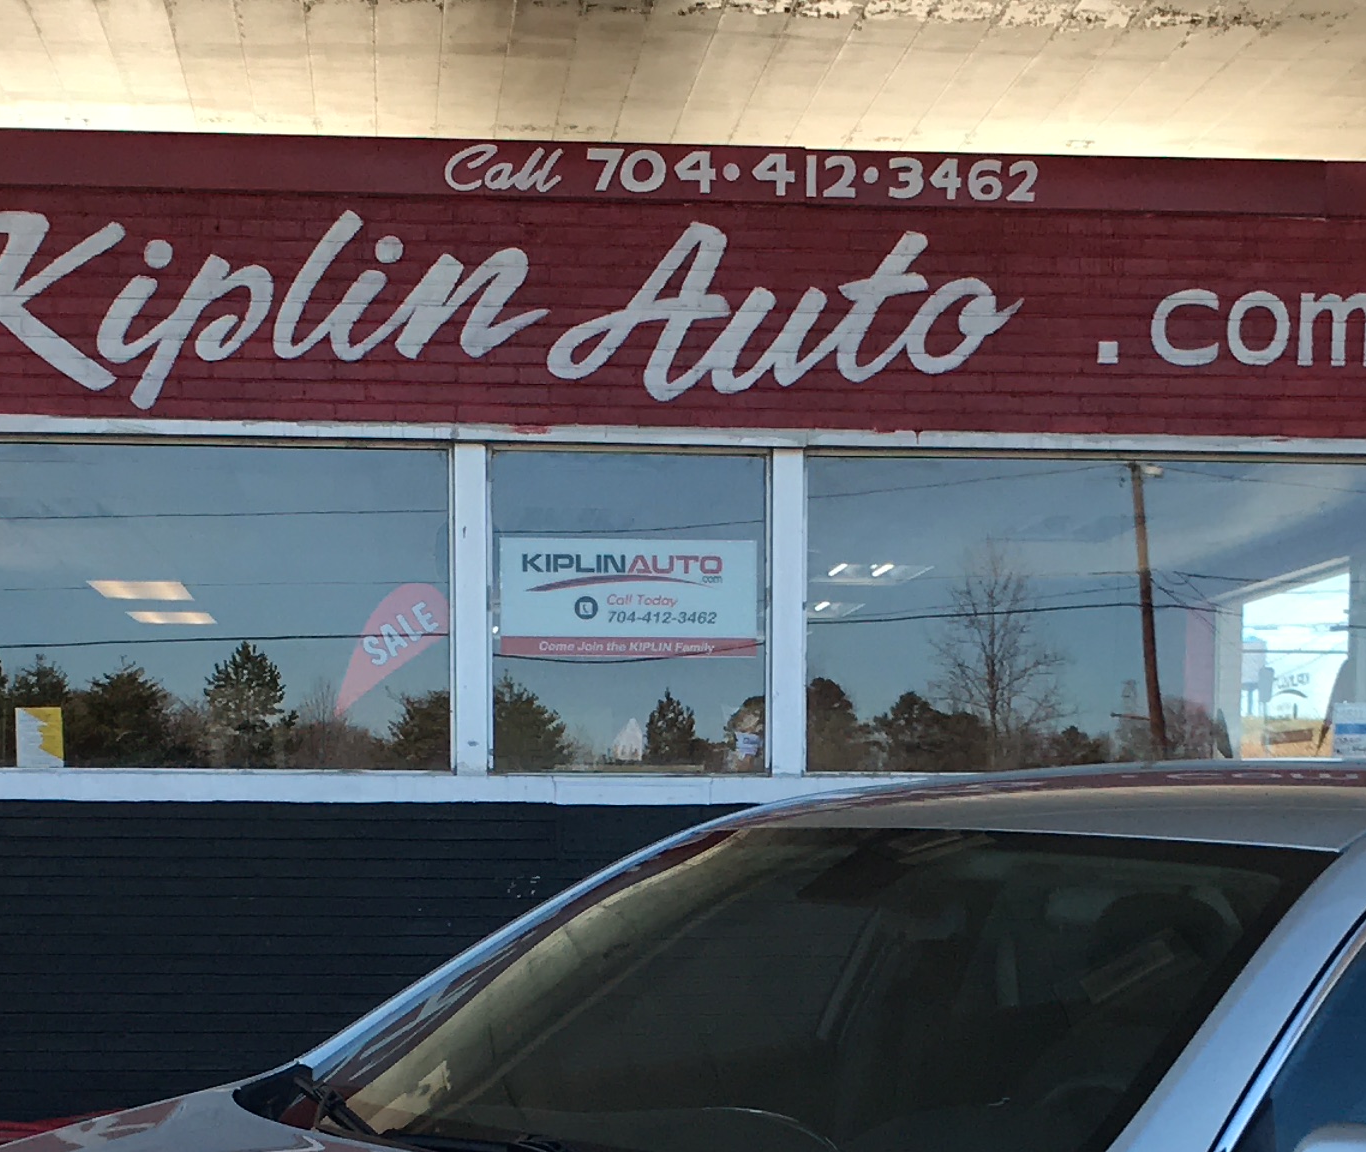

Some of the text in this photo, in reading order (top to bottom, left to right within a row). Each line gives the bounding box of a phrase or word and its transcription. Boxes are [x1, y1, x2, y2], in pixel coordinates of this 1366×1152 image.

[444, 143, 564, 193] Call
[546, 221, 1025, 401] Auto
[606, 594, 678, 608] Call Today
[362, 601, 439, 666] SALE
[607, 610, 718, 625] 704-412-3462
[538, 641, 715, 655] Come Join the KIPLIN Family
